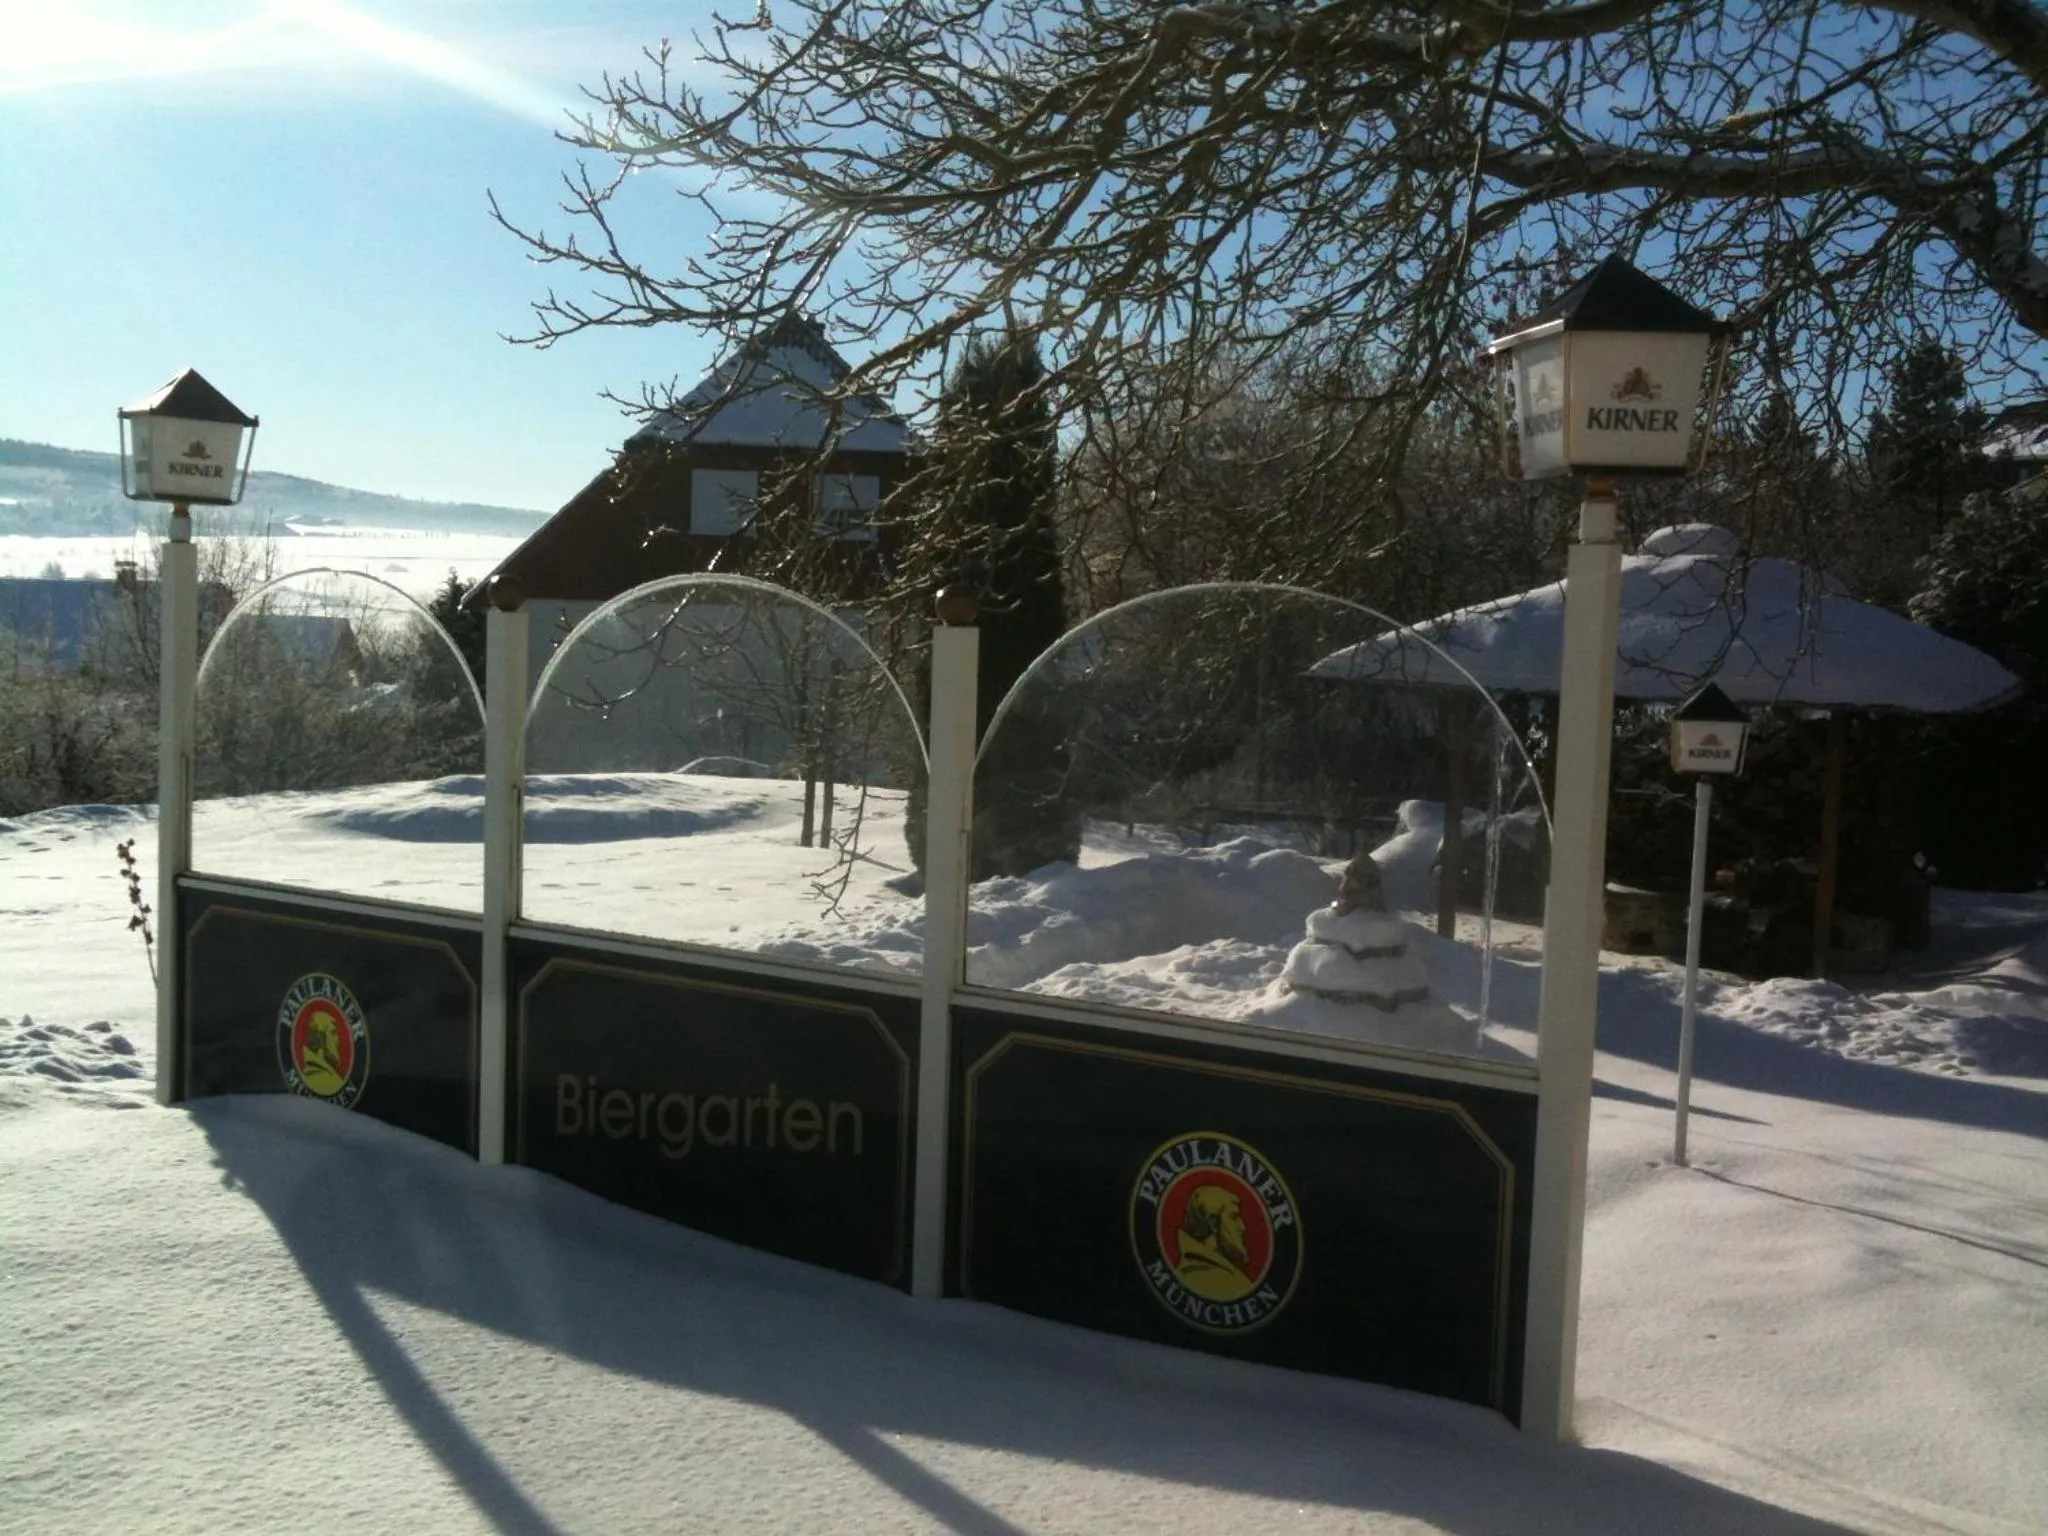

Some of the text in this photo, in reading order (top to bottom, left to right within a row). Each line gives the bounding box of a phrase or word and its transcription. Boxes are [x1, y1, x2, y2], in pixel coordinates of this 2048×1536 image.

[1587, 407, 1679, 432] KIRNER
[168, 461, 224, 478] KIRNER
[1688, 748, 1732, 759] KIRNER
[280, 978, 364, 1039] PAULANER
[555, 1073, 864, 1160] Biergarten
[1139, 1139, 1293, 1231] PAULANER
